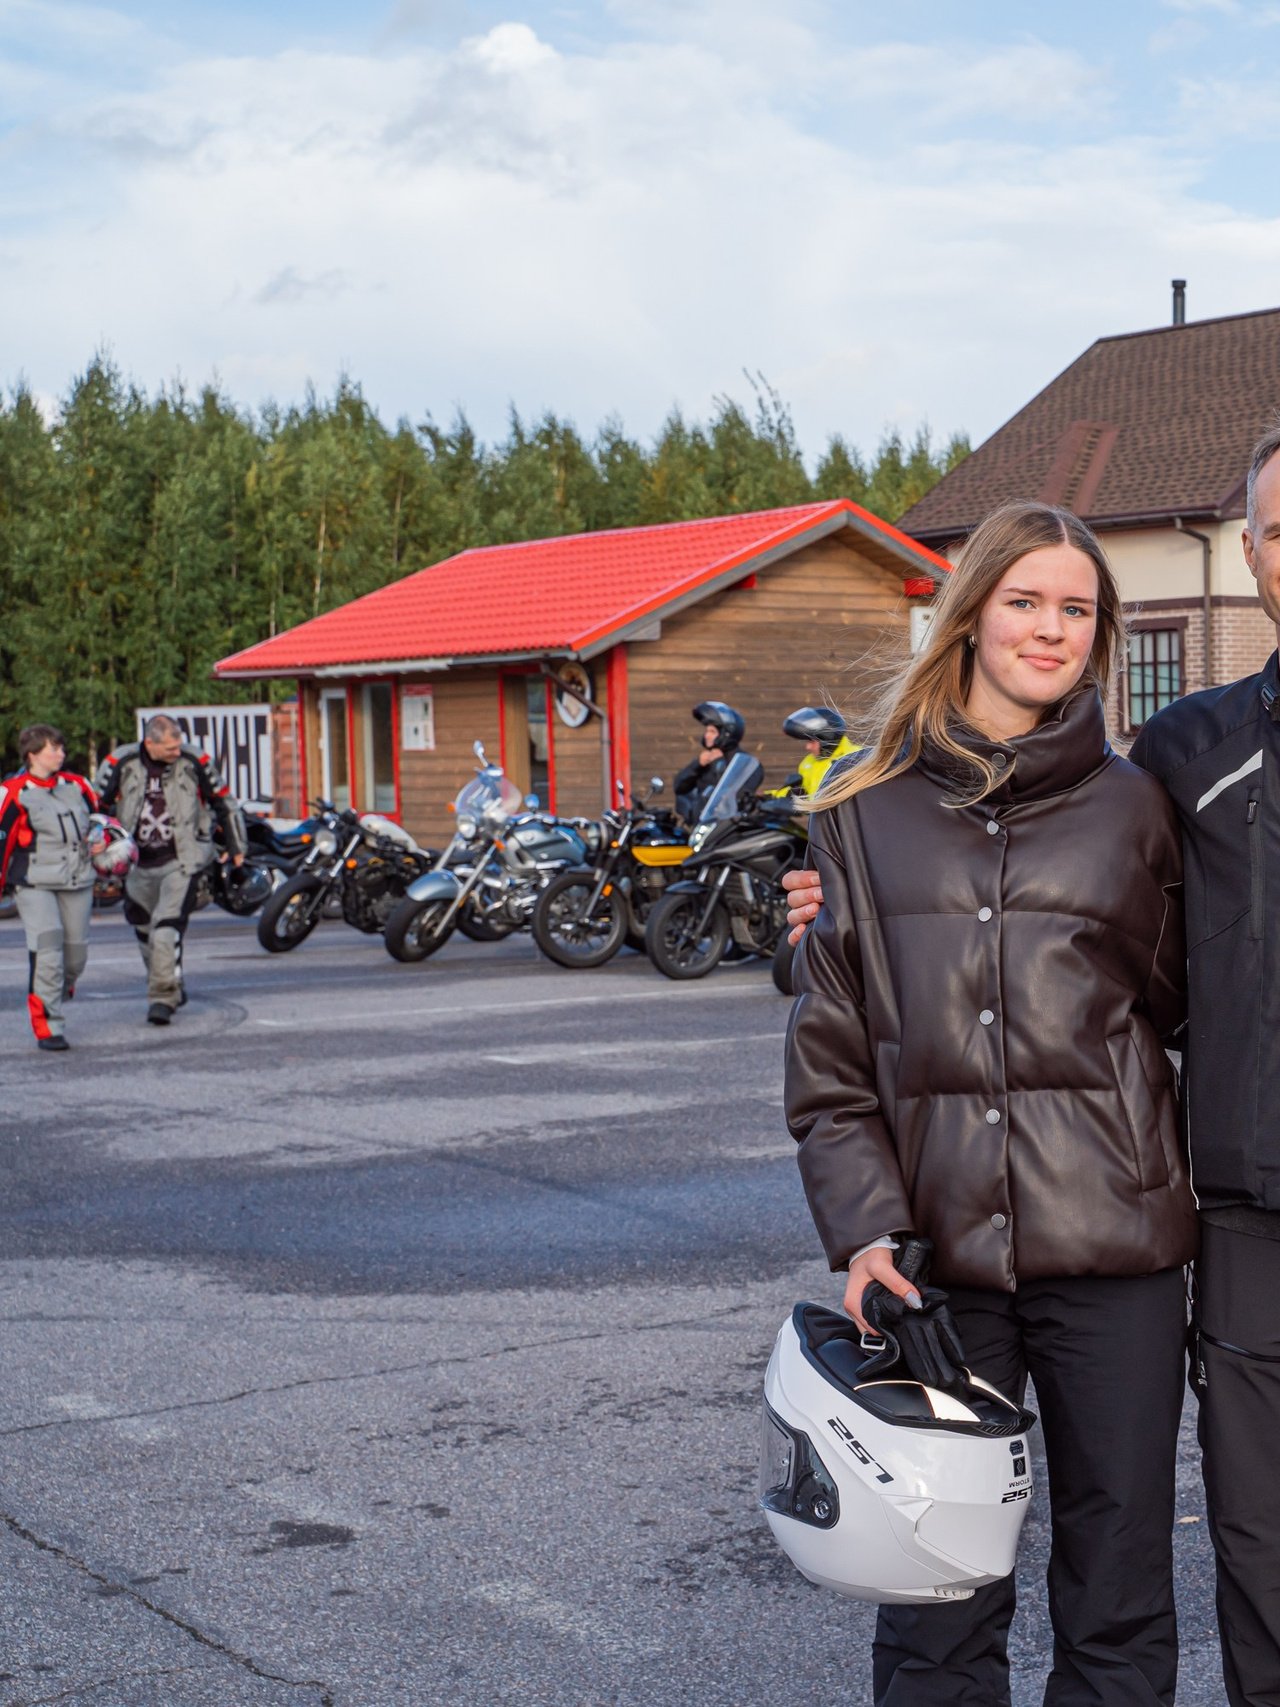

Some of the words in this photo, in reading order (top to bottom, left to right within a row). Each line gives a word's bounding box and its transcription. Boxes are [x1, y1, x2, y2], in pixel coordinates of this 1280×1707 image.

[142, 715, 268, 800] ТИНГ
[827, 1416, 894, 1483] LS2
[1008, 1477, 1030, 1488] STORM
